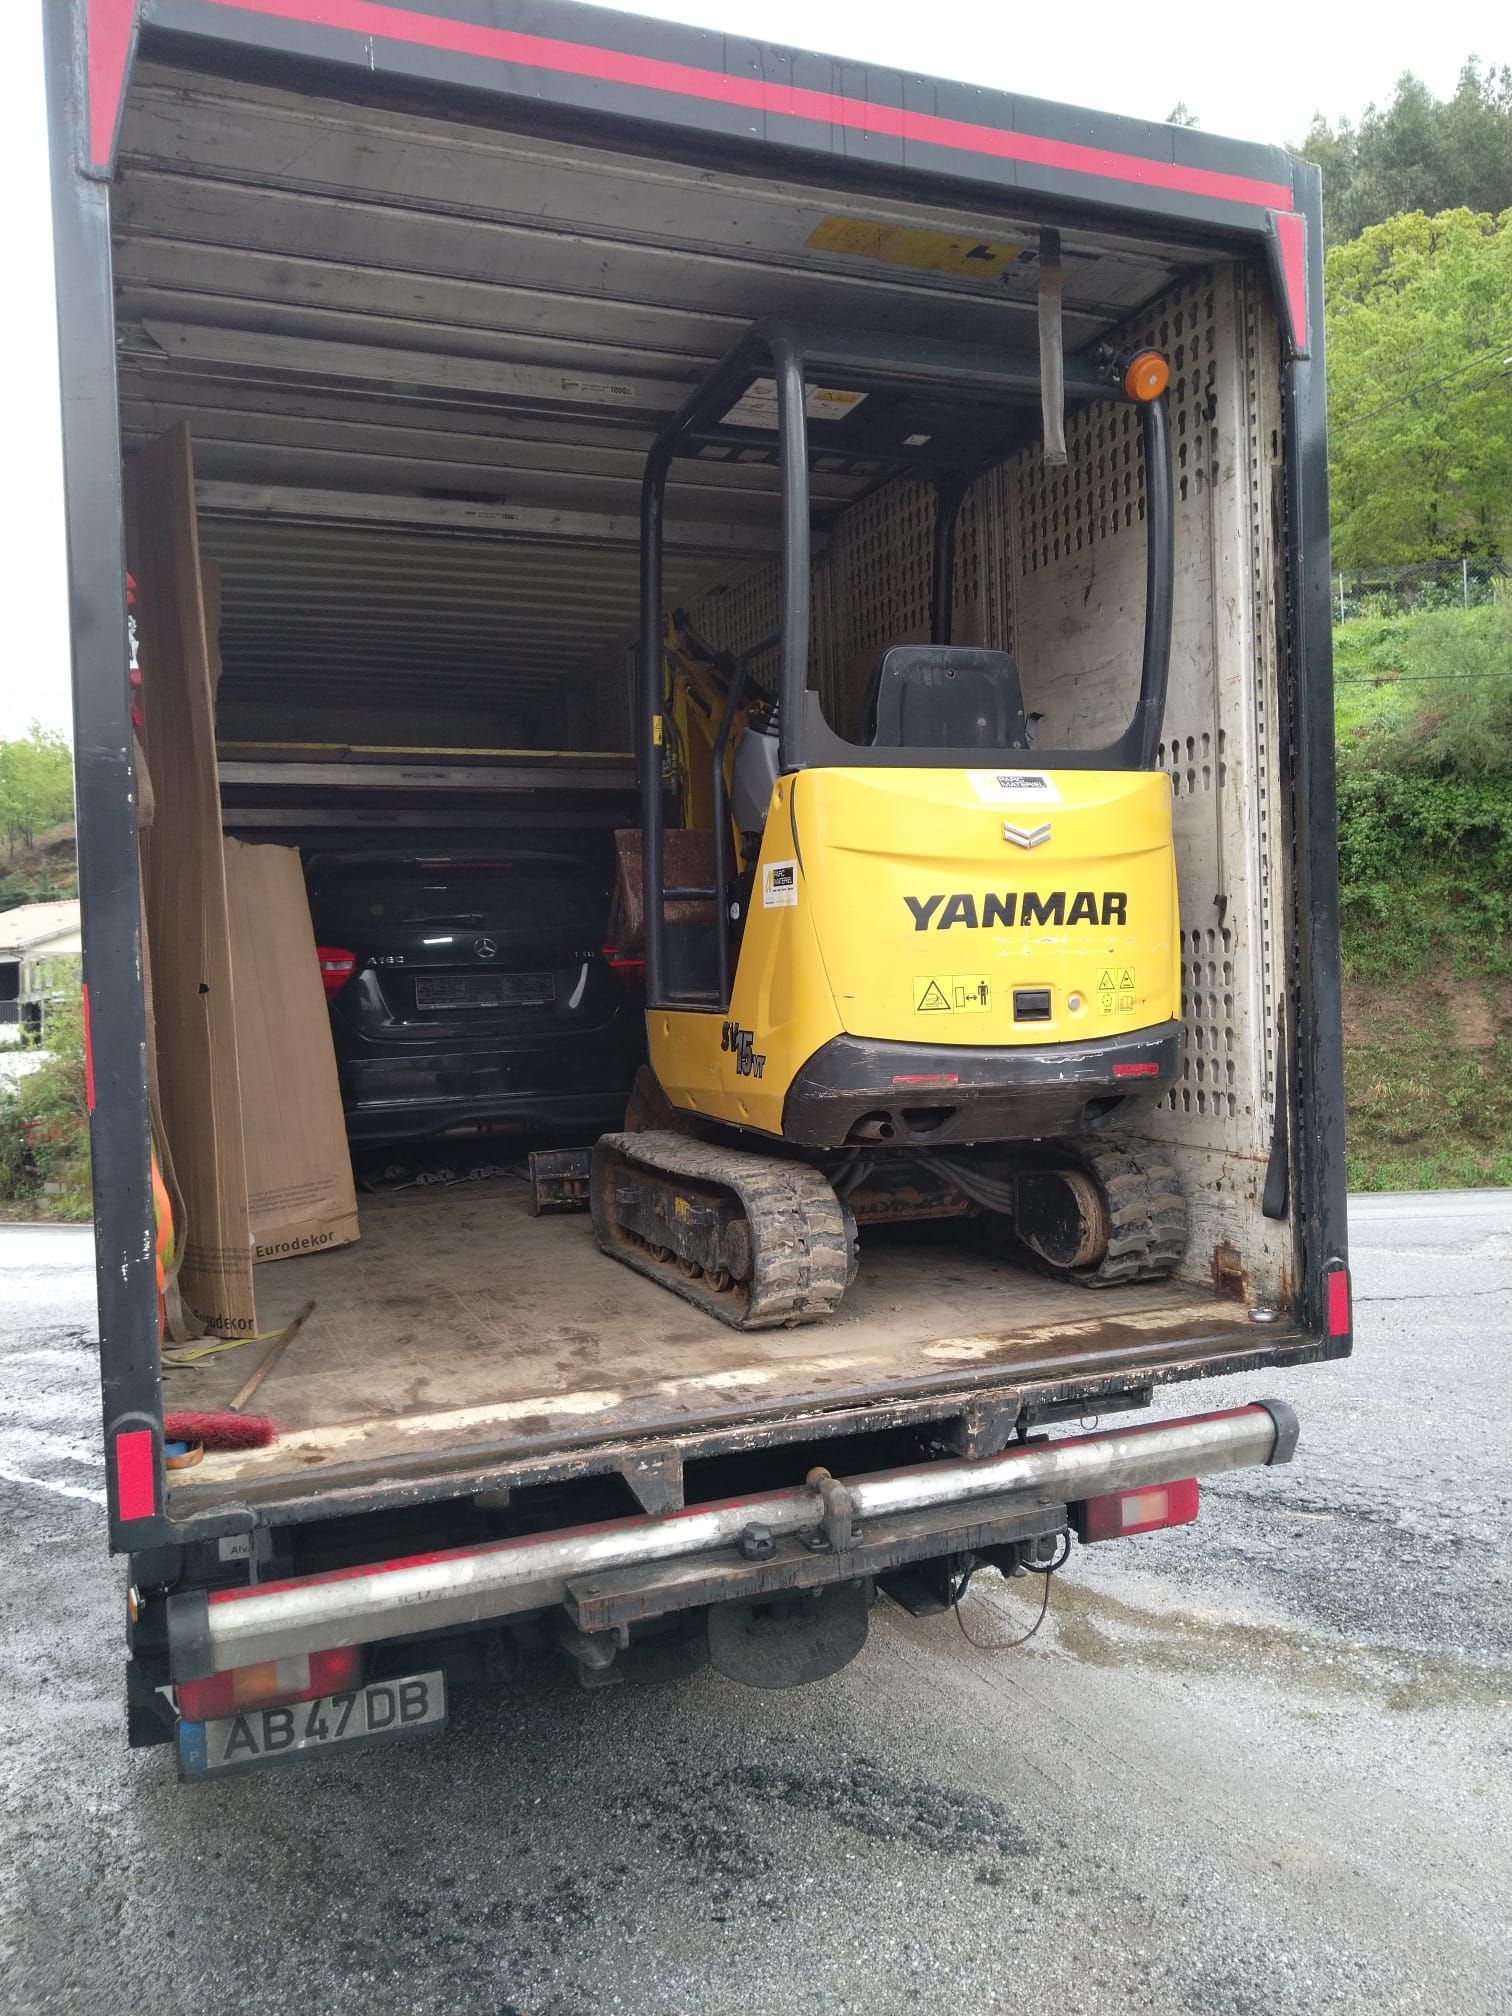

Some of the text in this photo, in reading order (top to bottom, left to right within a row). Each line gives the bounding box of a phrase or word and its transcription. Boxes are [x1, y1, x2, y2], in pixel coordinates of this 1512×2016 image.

[903, 891, 1128, 931] YANMAR
[255, 1231, 334, 1258] Eurodekor
[223, 1681, 428, 1760] AB 47 DB
[190, 1751, 198, 1763] P
